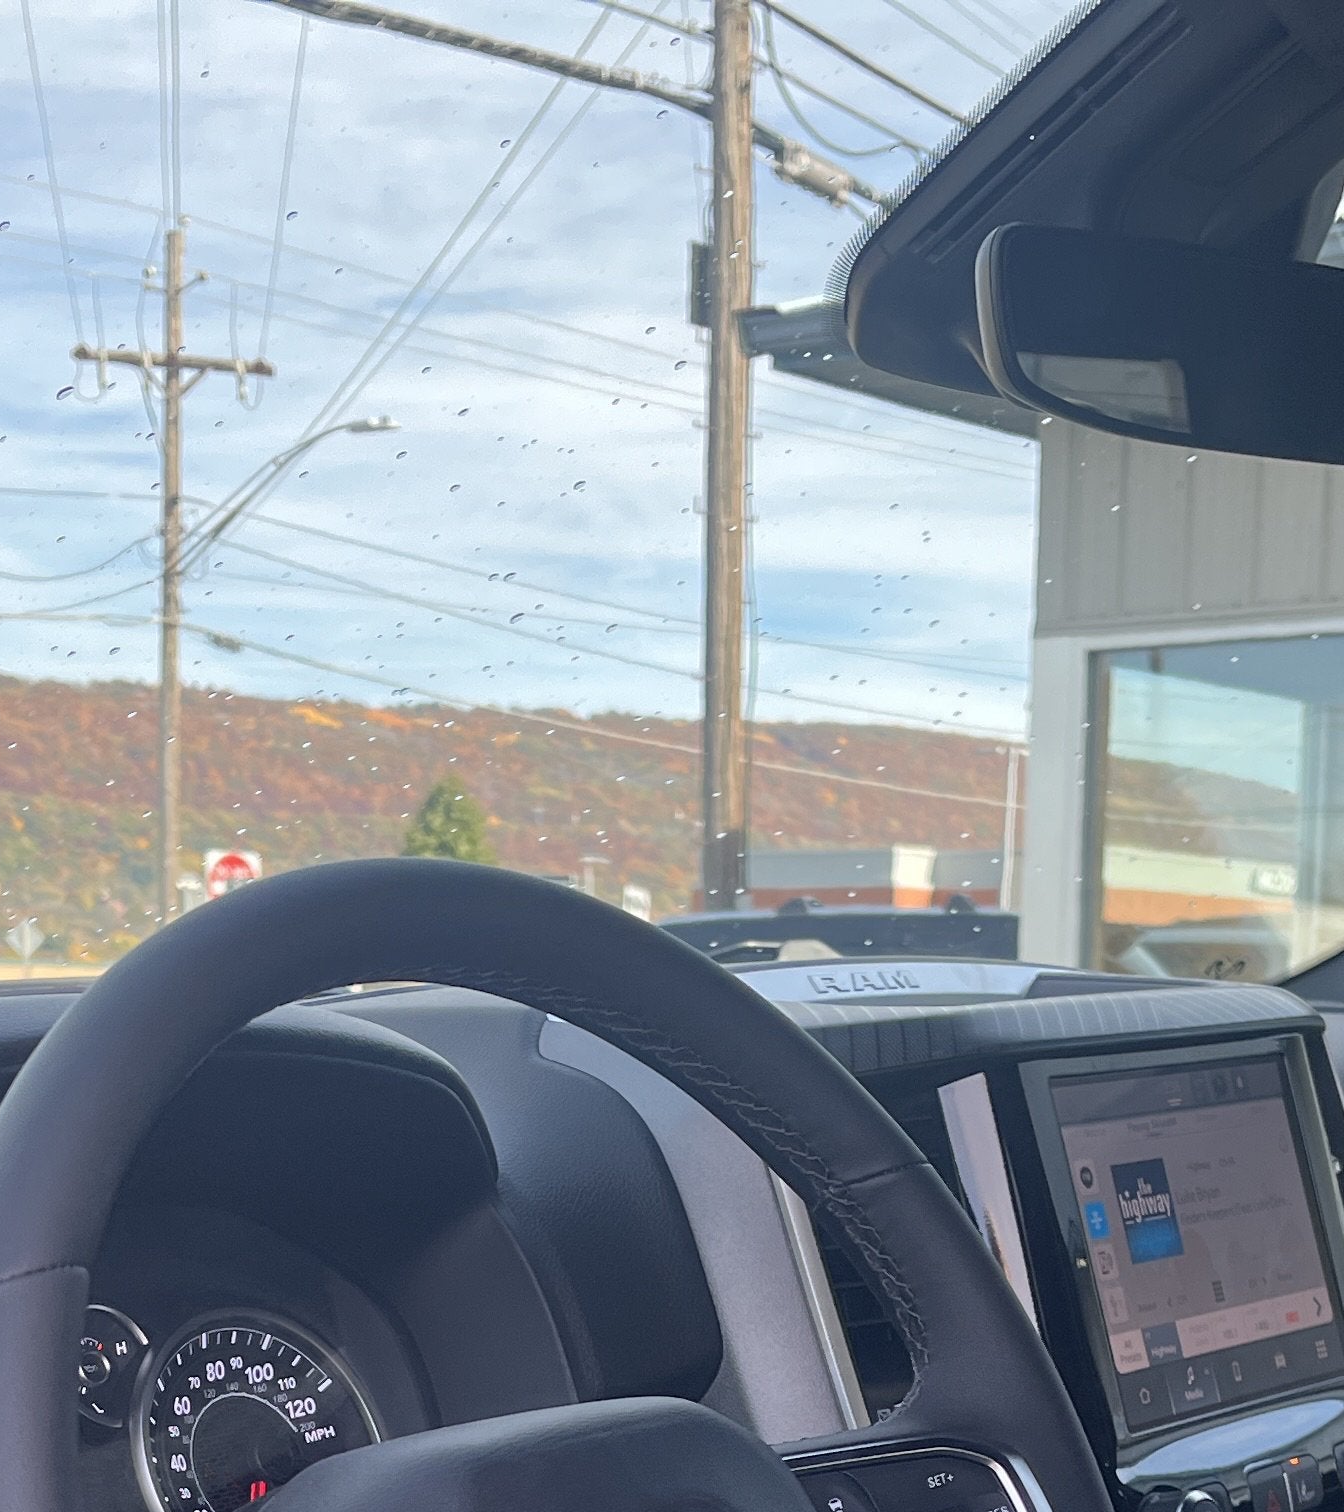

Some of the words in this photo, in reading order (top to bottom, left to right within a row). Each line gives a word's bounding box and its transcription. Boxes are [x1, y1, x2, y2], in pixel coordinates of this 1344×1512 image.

[806, 969, 921, 995] RAM
[1118, 1189, 1172, 1223] highway
[115, 1340, 128, 1356] H
[205, 1360, 225, 1382] 80
[229, 1356, 244, 1371] 90
[188, 1376, 201, 1390] 70
[244, 1362, 274, 1385] 100
[277, 1376, 297, 1391] 110
[173, 1396, 191, 1416] 60
[284, 1397, 316, 1419] 120
[167, 1425, 180, 1438] 50
[304, 1425, 336, 1443] MPH
[170, 1453, 187, 1472] 40
